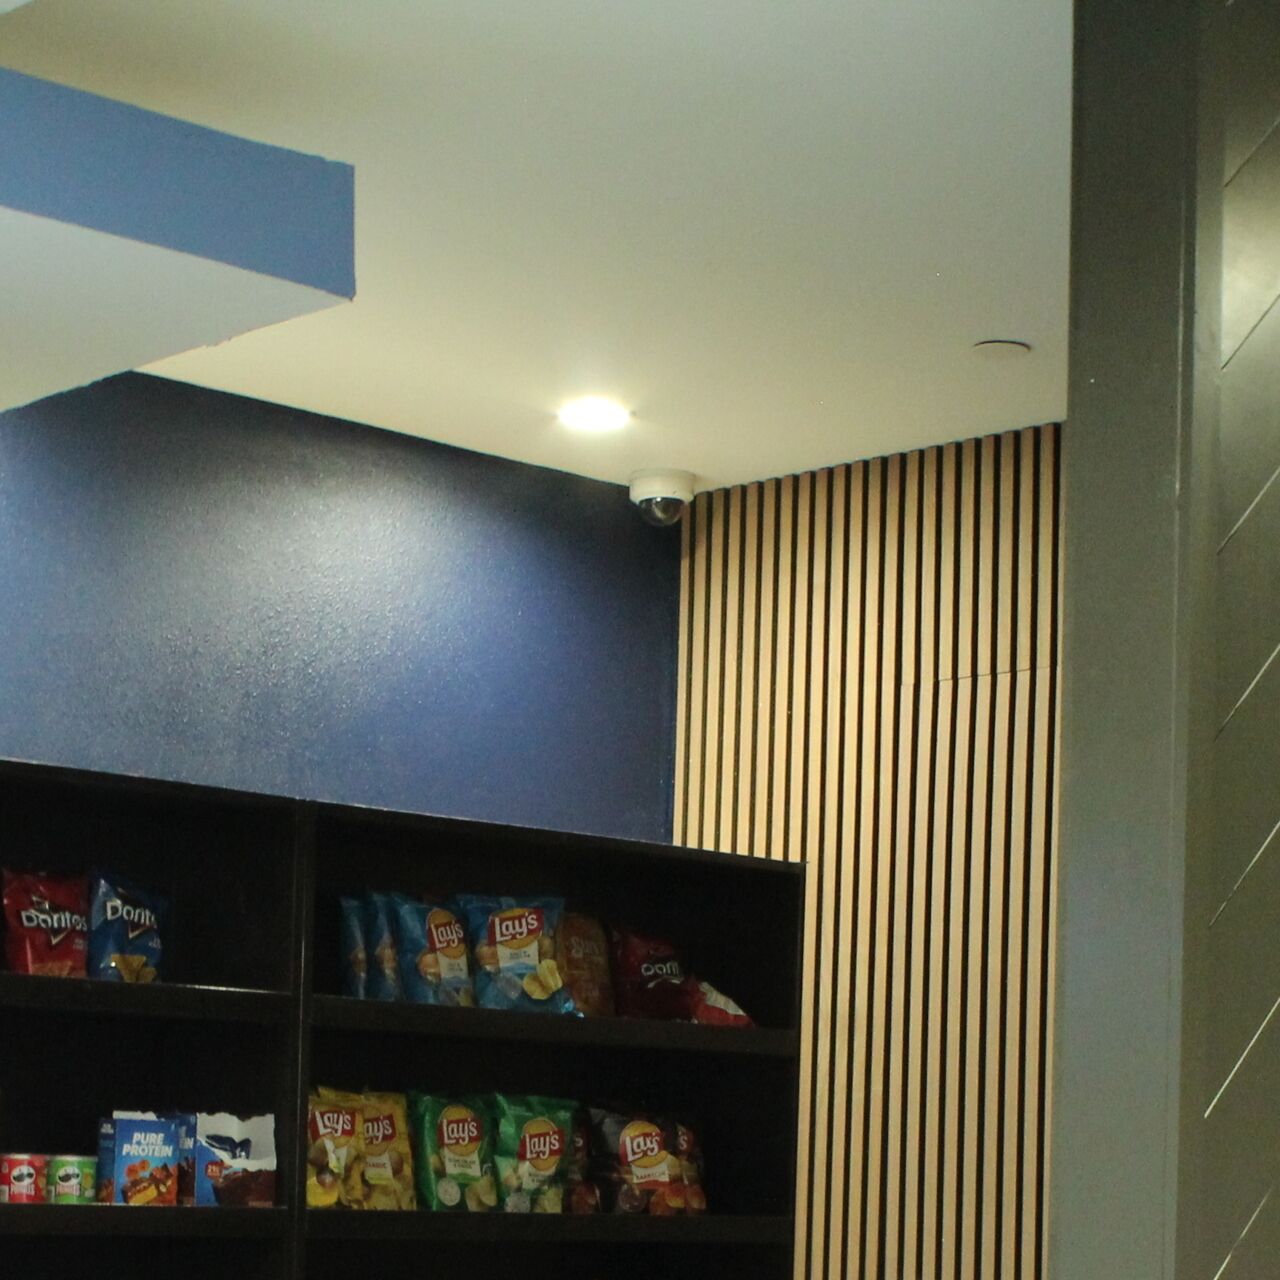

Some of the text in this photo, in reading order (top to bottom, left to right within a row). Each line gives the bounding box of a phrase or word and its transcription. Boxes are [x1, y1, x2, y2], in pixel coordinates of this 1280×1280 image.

[21, 909, 88, 931] Doritos
[495, 912, 538, 942] Lay's
[430, 920, 464, 948] Lay's
[315, 1110, 353, 1136] Lay's
[443, 1118, 478, 1144] Lay's
[122, 1144, 173, 1158] PROTEIN
[133, 1132, 166, 1145] PURE
[526, 1130, 560, 1159] Lay's
[625, 1132, 661, 1161] Lay's
